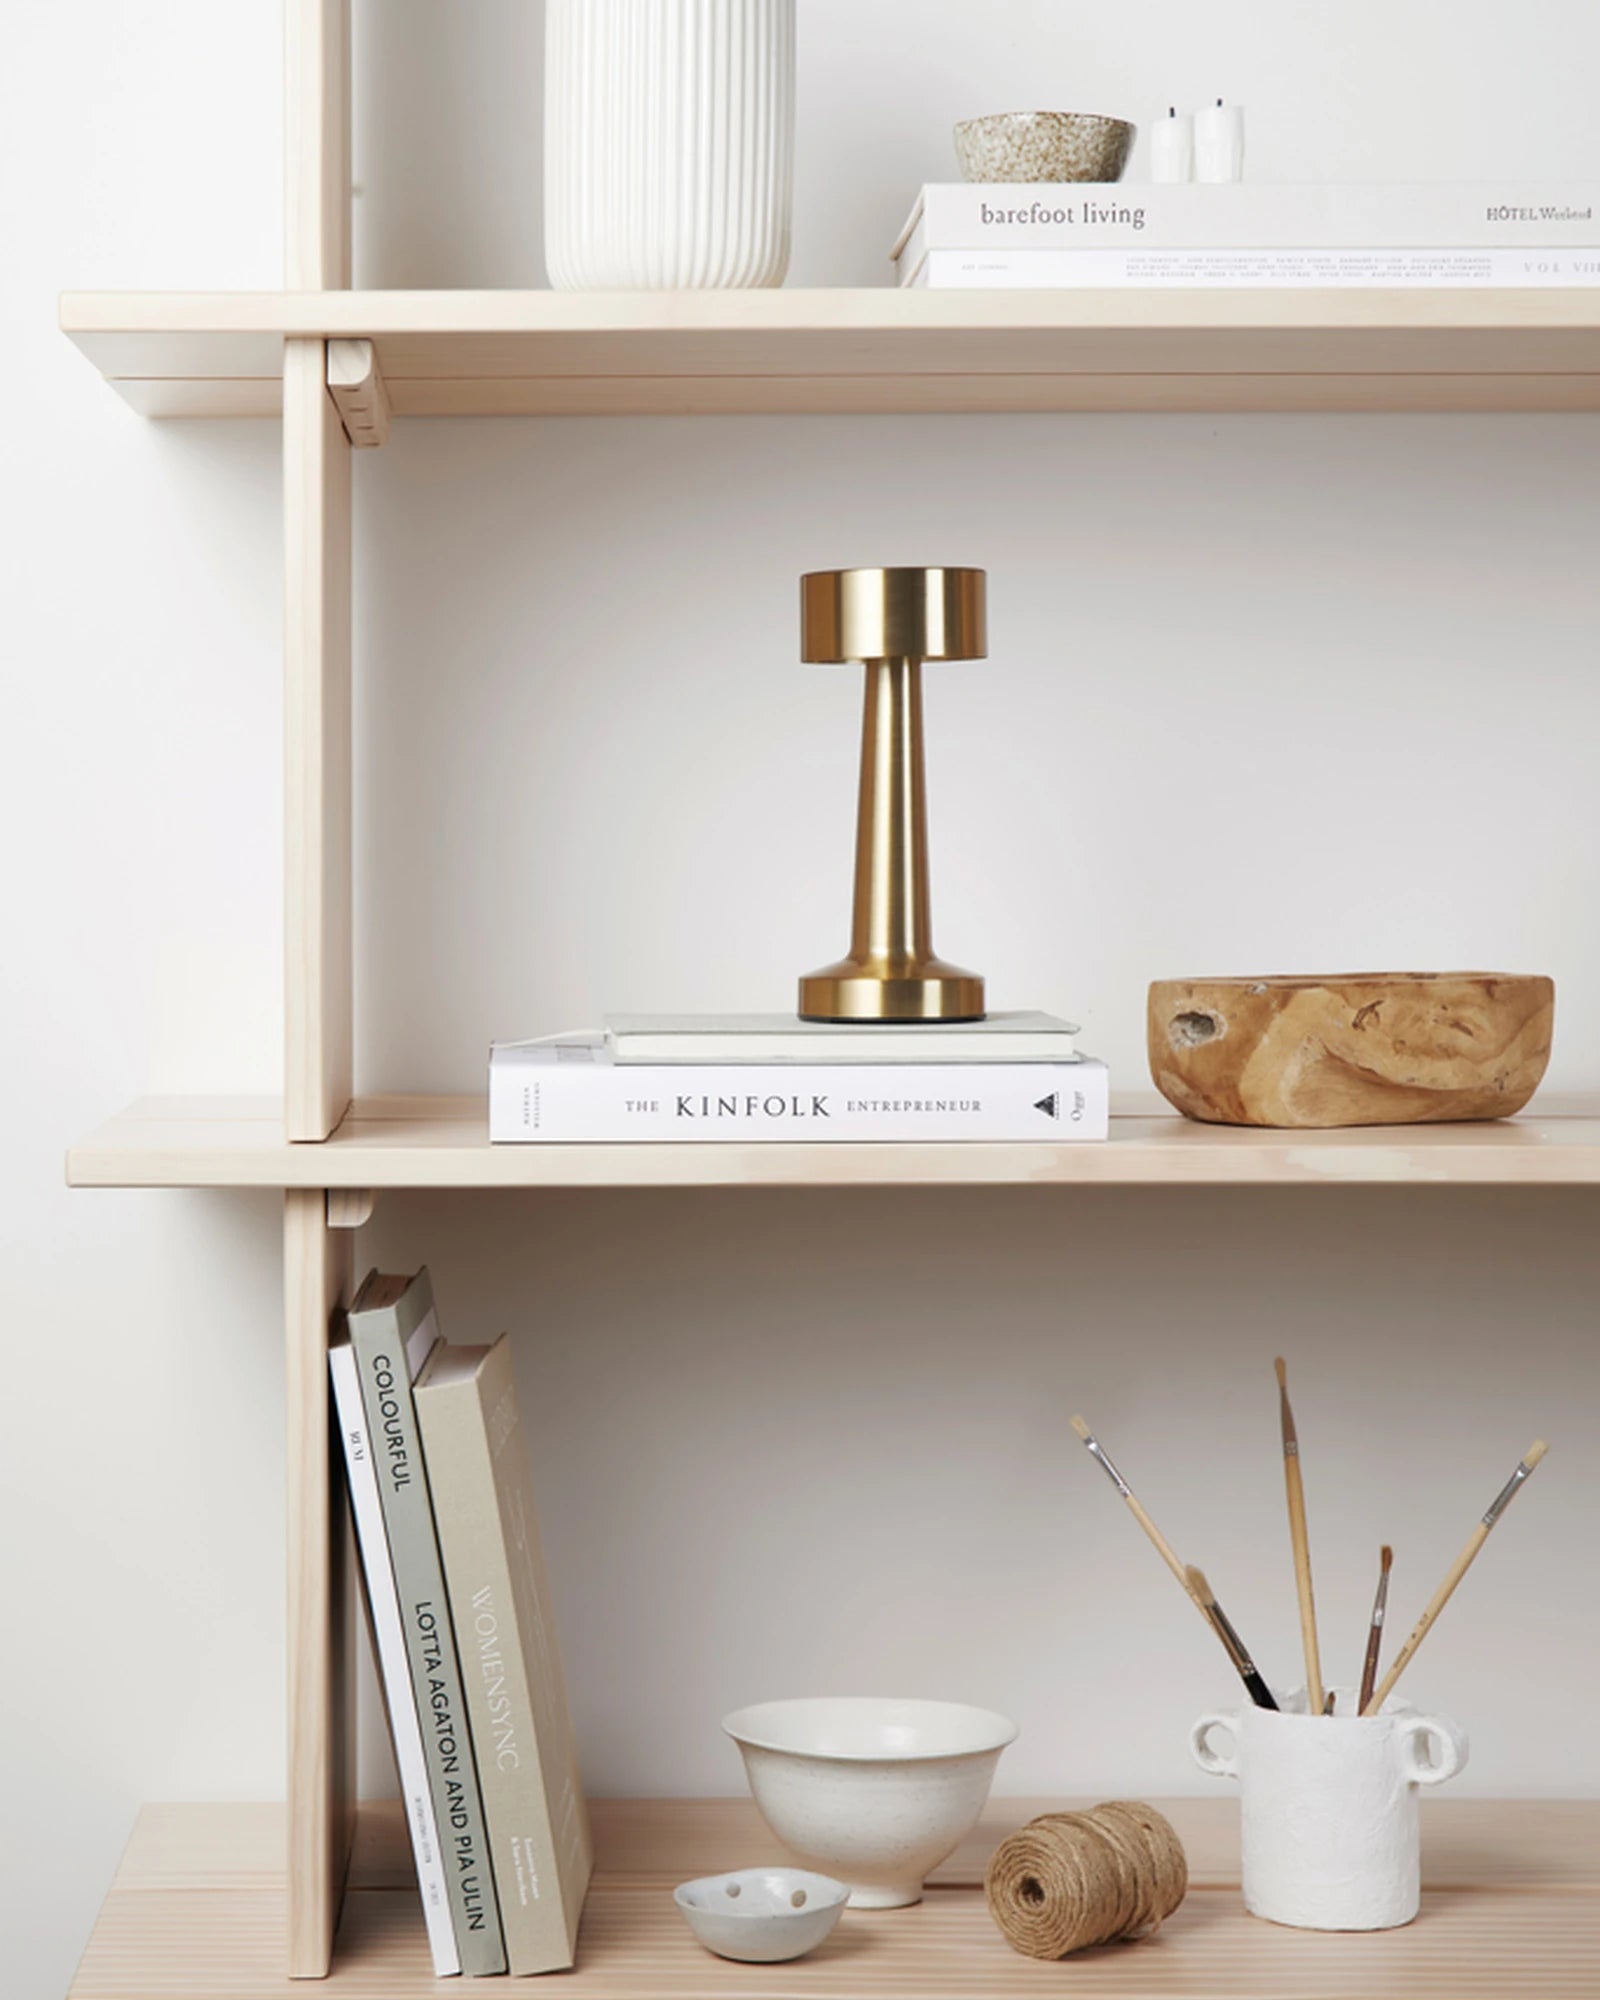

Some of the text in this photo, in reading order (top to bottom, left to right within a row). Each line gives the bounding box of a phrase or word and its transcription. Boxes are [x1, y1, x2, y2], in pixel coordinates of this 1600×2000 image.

[981, 202, 1145, 229] barefoot living
[625, 1096, 982, 1117] THE KINFOLK ENTREPRENEUR
[373, 1355, 411, 1493] COLOURFUL
[472, 1585, 519, 1772] WOMENSYNC
[415, 1601, 486, 1931] LOTTA AGATON AND PIA ULIN
